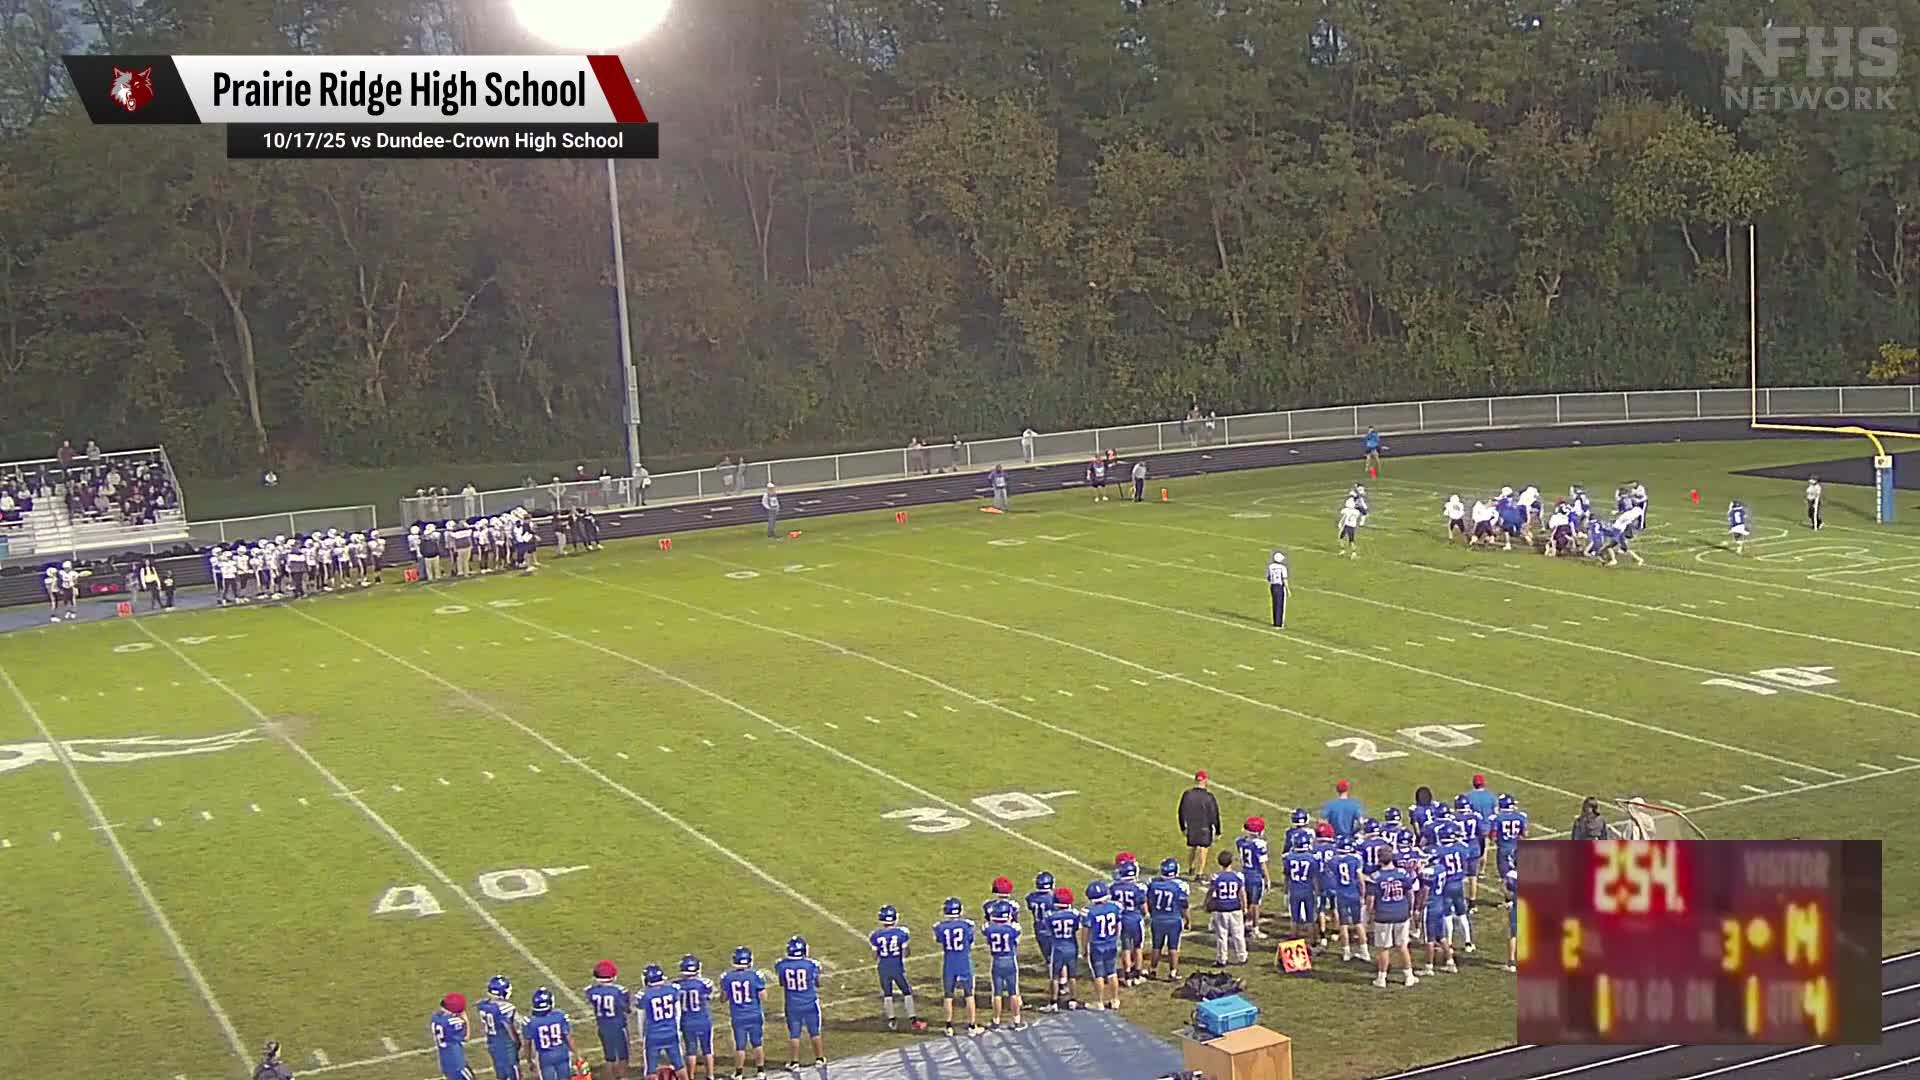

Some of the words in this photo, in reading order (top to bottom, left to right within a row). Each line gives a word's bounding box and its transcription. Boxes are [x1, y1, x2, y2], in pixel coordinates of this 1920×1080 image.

[1327, 724, 1481, 761] 20
[880, 792, 1054, 834] 30
[1502, 821, 1521, 840] 56
[1290, 861, 1310, 882] 27
[1444, 852, 1463, 875] 51
[376, 868, 549, 916] 40
[1154, 889, 1174, 911] 77
[1218, 882, 1238, 900] 28
[1052, 919, 1074, 939] 26
[1095, 913, 1116, 938] 72
[876, 935, 900, 957] 34
[943, 928, 964, 951] 12
[991, 933, 1011, 953] 21
[784, 968, 808, 991] 68
[731, 980, 752, 1005] 61
[591, 994, 616, 1017] 79
[651, 994, 674, 1022] 65
[538, 1023, 562, 1050] 69
